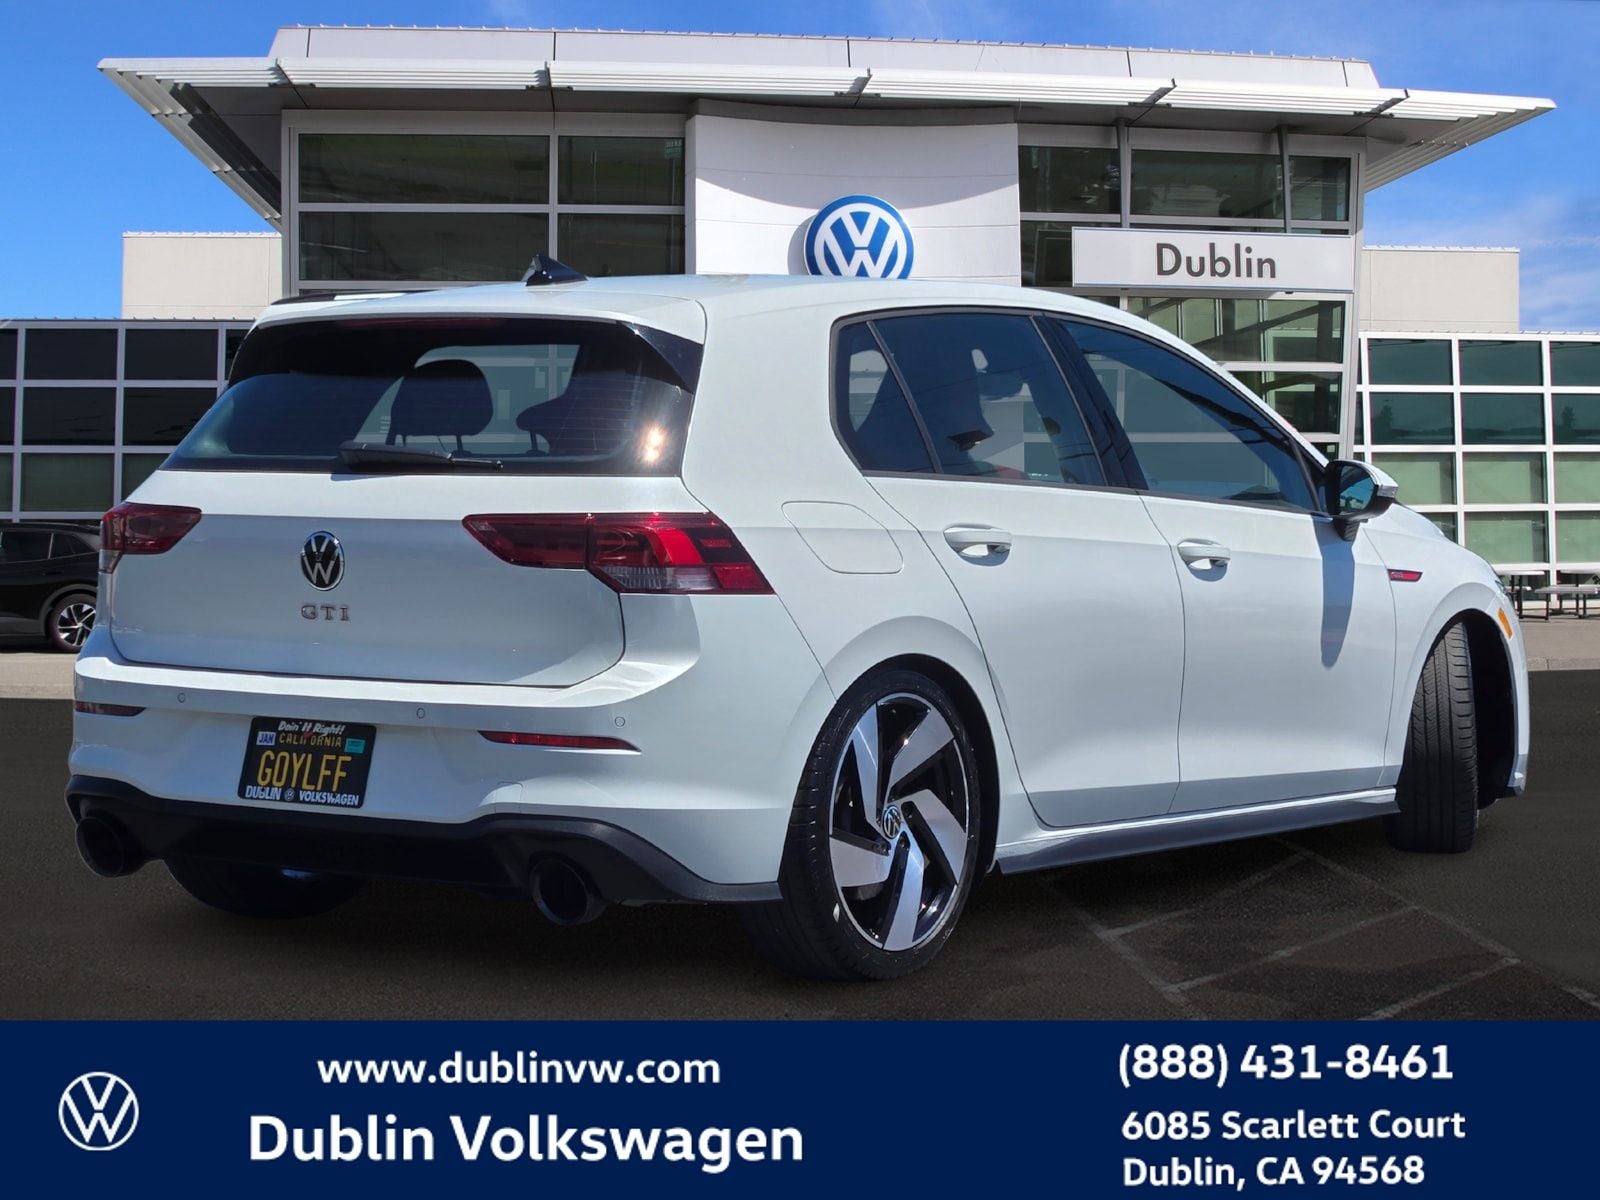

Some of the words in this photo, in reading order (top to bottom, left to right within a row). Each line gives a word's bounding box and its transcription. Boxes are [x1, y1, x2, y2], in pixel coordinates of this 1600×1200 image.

[806, 195, 914, 279] VW
[1156, 242, 1276, 279] Dublin
[301, 531, 345, 590] VW
[301, 605, 350, 621] GTI
[259, 733, 275, 744] JAN
[279, 721, 302, 731] Doin'
[313, 724, 345, 737] Right!
[246, 786, 282, 800] DUBLIN
[299, 790, 359, 805] VOLKSWAGEN
